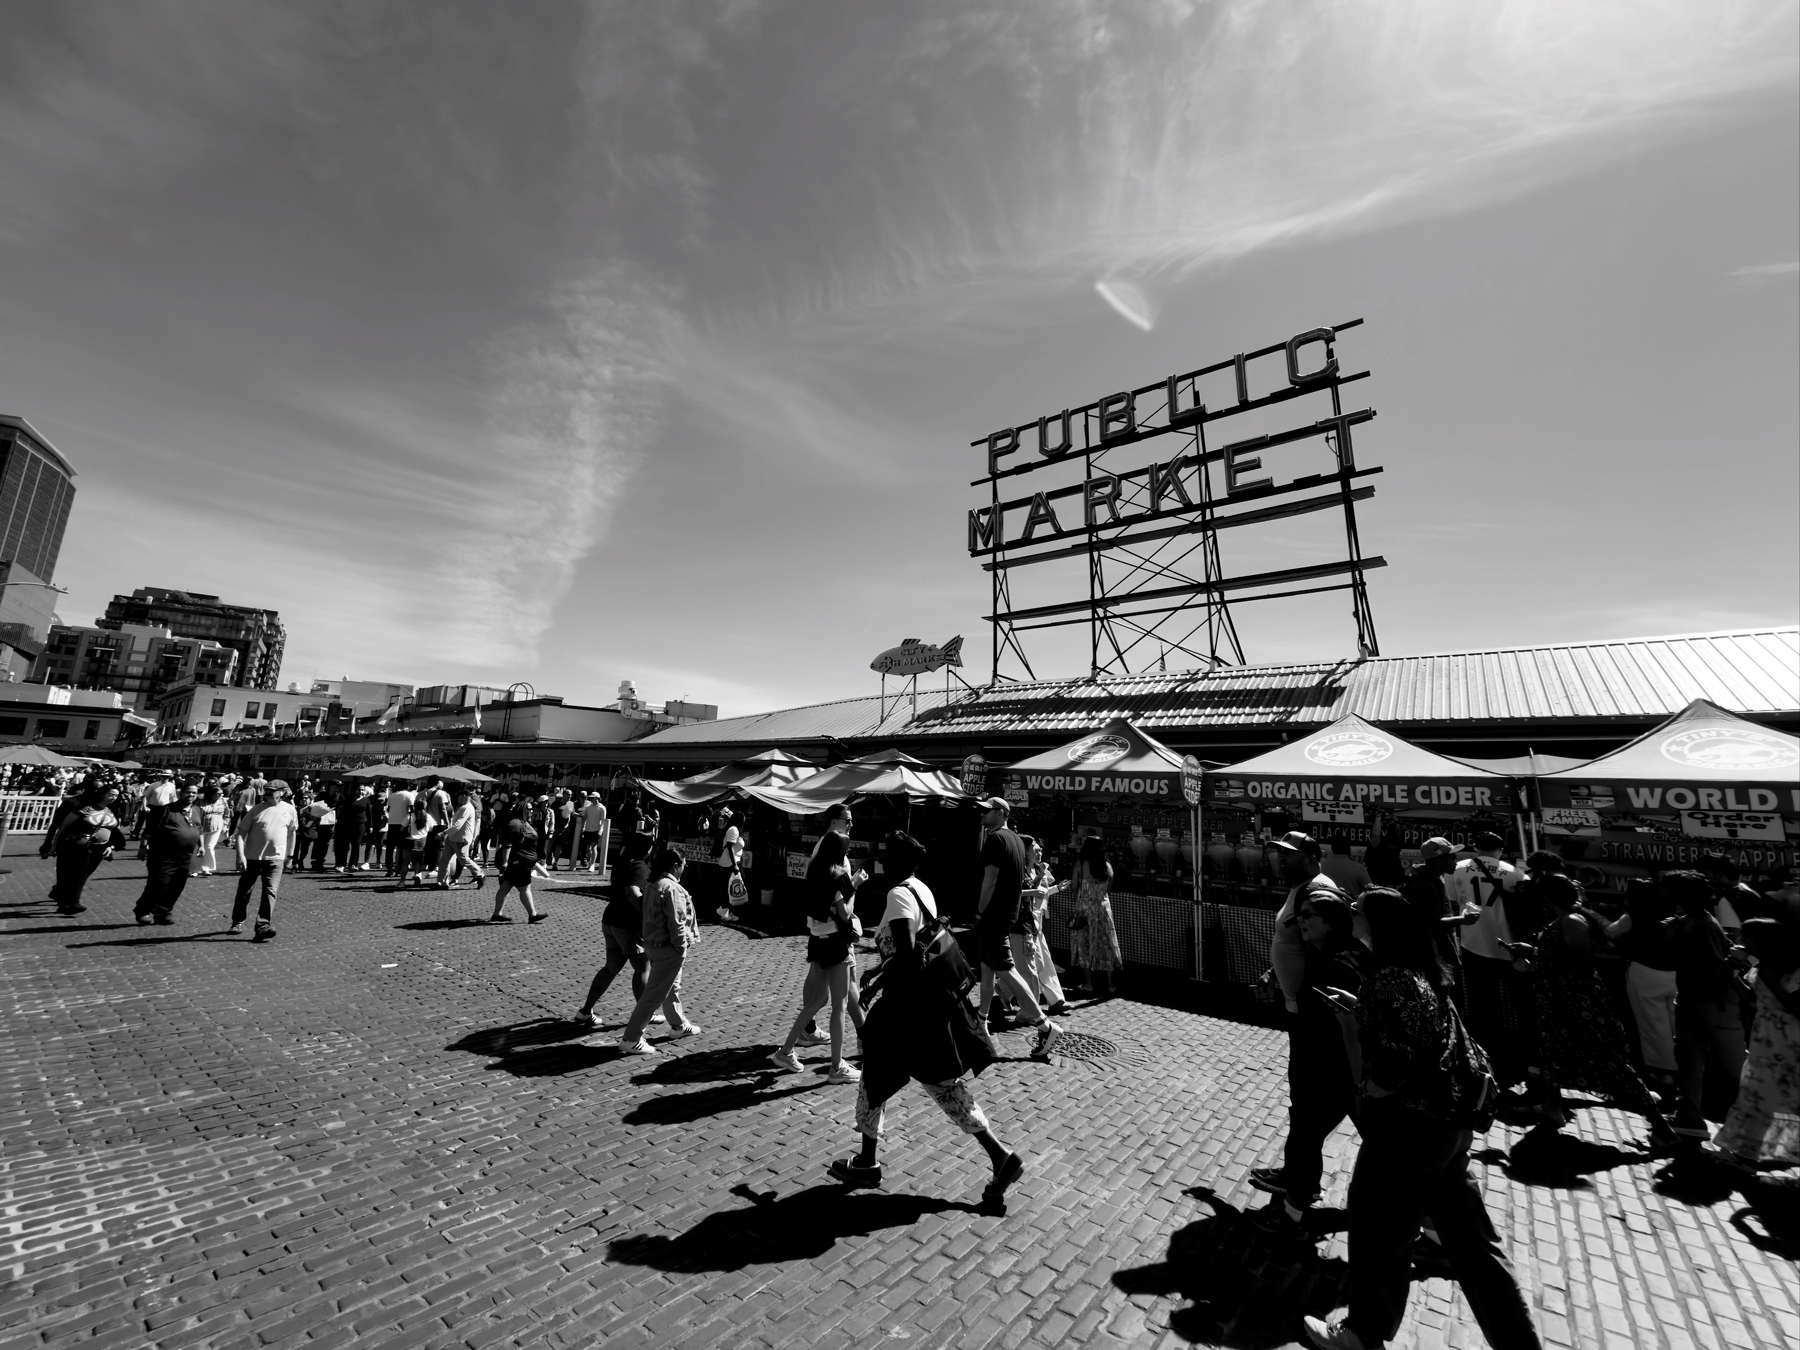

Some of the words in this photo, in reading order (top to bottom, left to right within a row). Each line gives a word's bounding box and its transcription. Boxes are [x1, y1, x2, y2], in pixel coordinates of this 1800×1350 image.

[987, 326, 1340, 475] PUBLIC
[967, 406, 1374, 552] MARKET
[900, 646, 925, 656] CITY
[1320, 733, 1378, 744] TINY'S
[1676, 730, 1766, 743] TINY'S
[963, 773, 986, 784] APPLE
[1026, 775, 1087, 790] WORLD
[1091, 777, 1169, 795] FAMOUS
[1184, 777, 1202, 791] APPLE
[962, 782, 985, 795] CIDER
[1247, 781, 1333, 800] ORGANIC
[1339, 783, 1409, 804] APPLE
[1415, 785, 1492, 806] CIDER
[1184, 788, 1201, 804] CIDER
[1626, 787, 1778, 811] WORLD
[1306, 801, 1359, 809] Order
[1553, 810, 1587, 818] FREE
[1687, 811, 1775, 822] Order
[1117, 815, 1149, 826] PEACH
[1153, 817, 1186, 828] APPLE
[1545, 817, 1599, 828] SAMPLE
[1700, 820, 1767, 830] Here
[1312, 826, 1388, 841] BLAKBERY
[788, 860, 804, 870] Apple
[791, 869, 805, 877] Pear
[1470, 876, 1503, 907] 17
